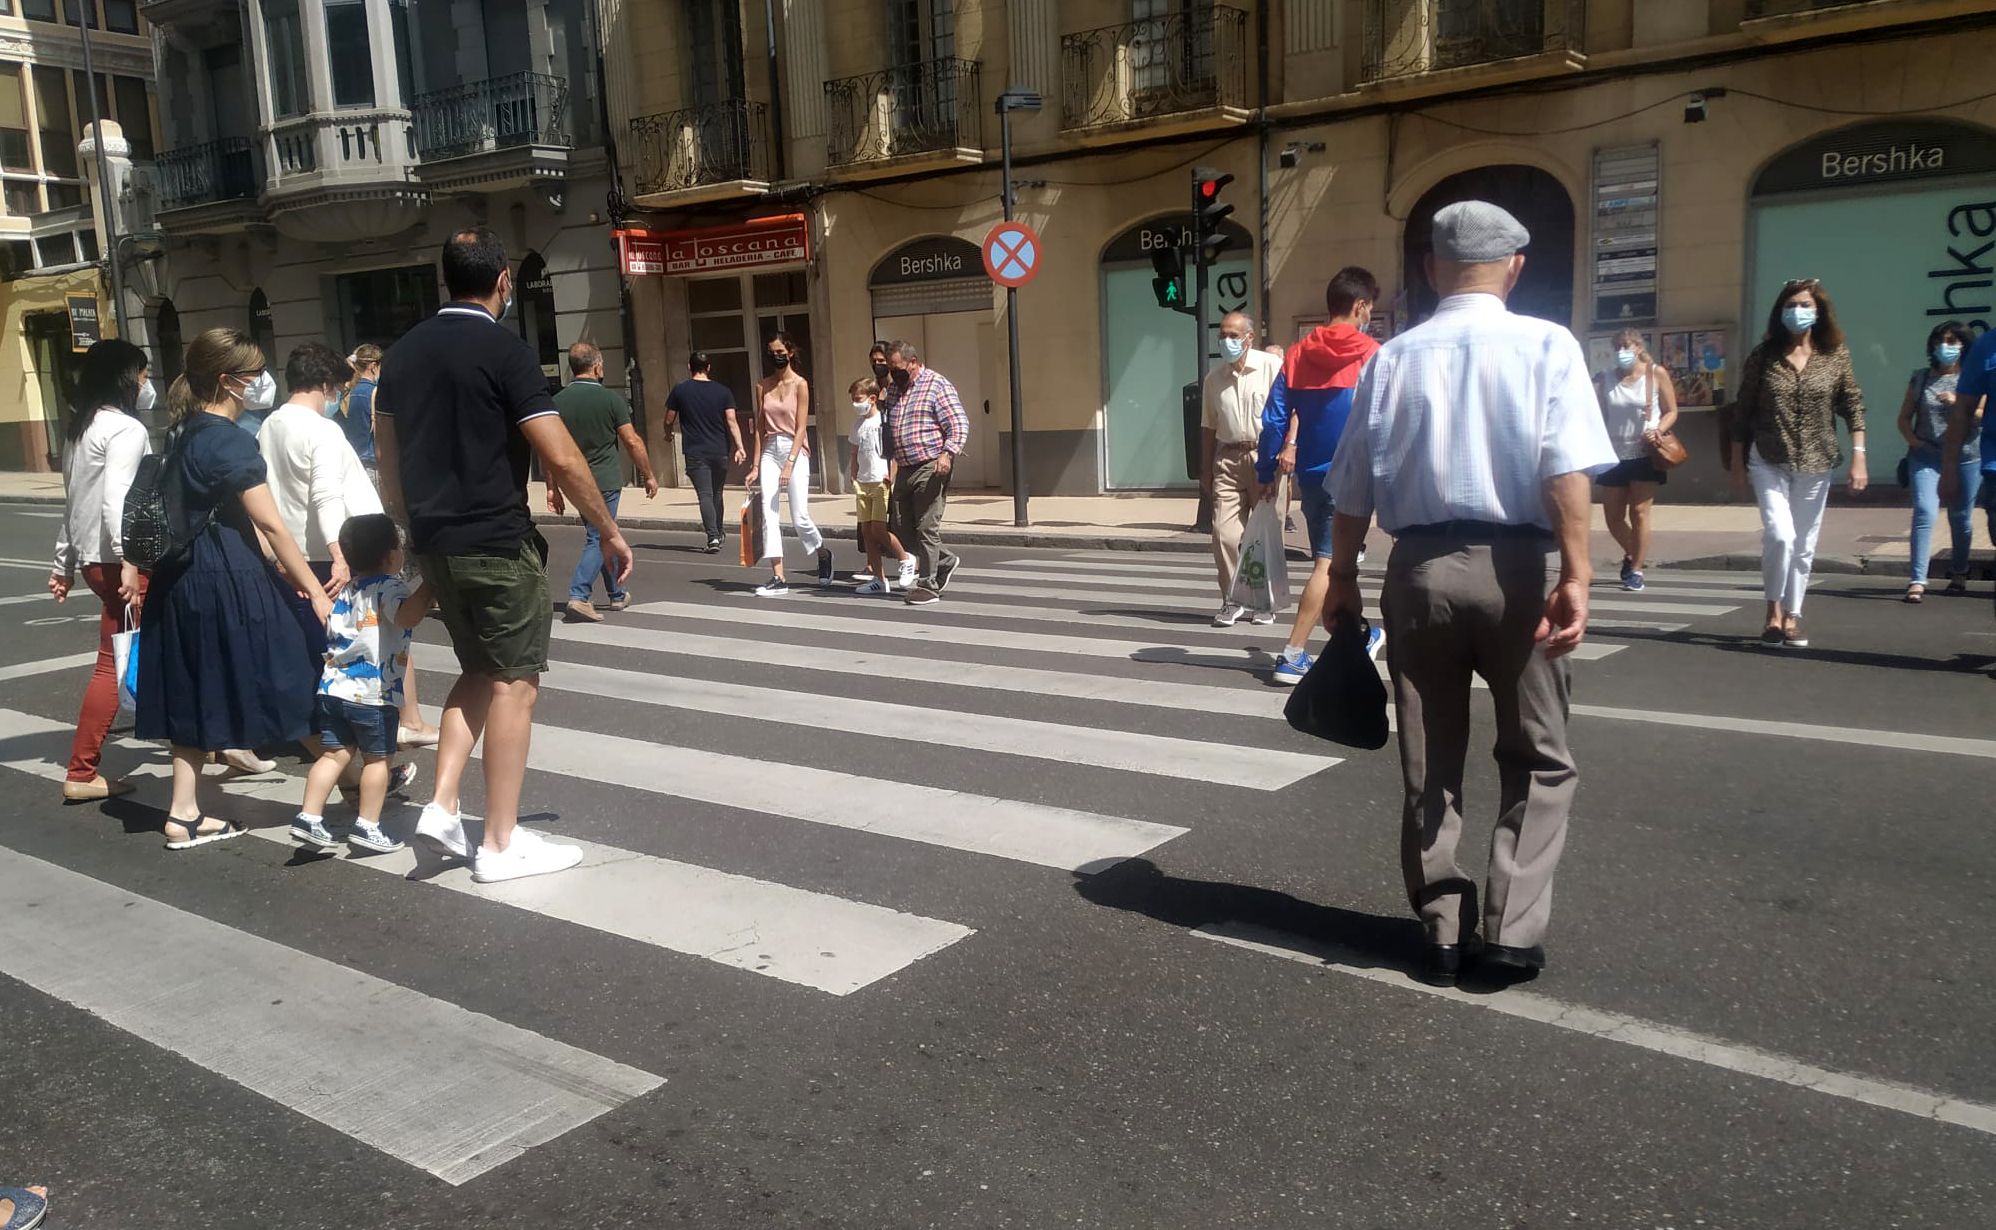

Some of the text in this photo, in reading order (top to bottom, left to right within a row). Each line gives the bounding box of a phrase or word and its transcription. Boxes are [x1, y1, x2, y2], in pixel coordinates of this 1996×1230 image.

[1822, 144, 1944, 177] Bershka
[681, 228, 802, 260] Toscana
[672, 261, 690, 270] BAR
[713, 253, 763, 265] HELADERIA
[901, 252, 961, 275] Bershka
